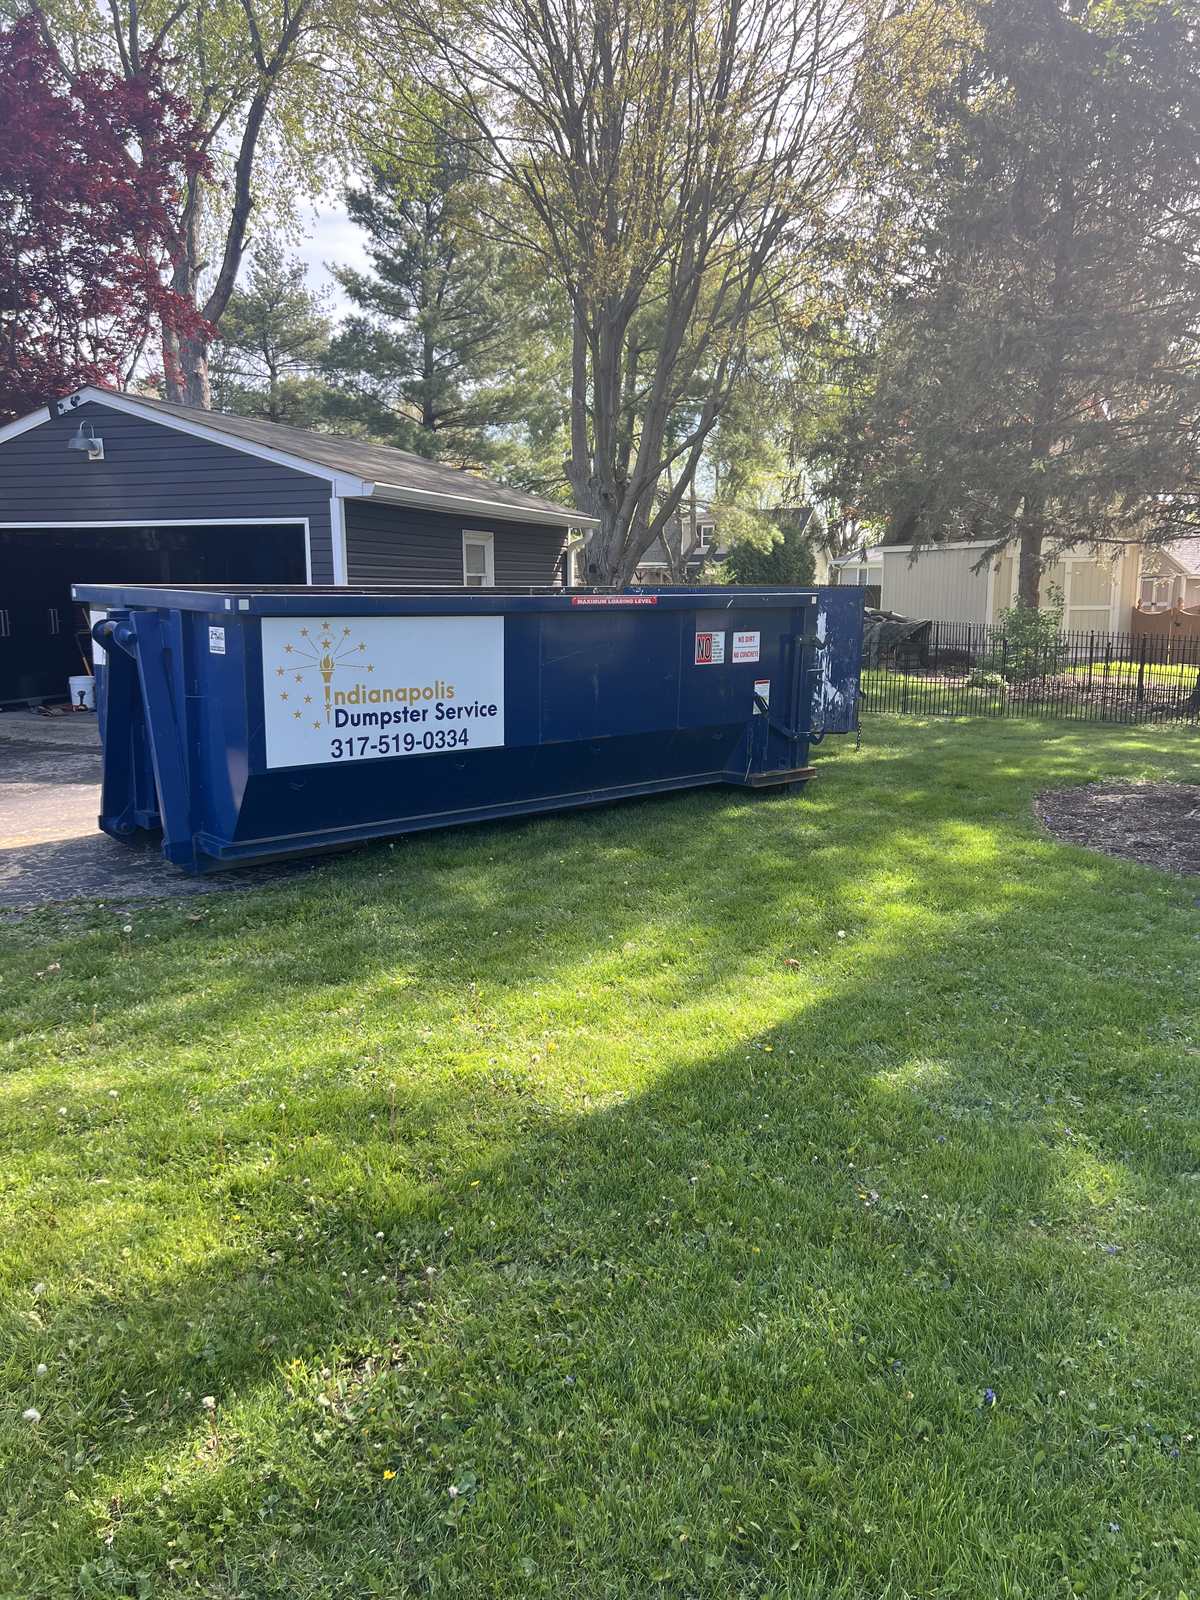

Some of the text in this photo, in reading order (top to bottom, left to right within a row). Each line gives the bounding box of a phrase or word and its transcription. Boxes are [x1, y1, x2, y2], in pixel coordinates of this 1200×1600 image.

[697, 637, 712, 659] NO
[324, 680, 456, 706] Indianapolis
[335, 701, 498, 729] Dumpster Service
[330, 728, 469, 758] 317-519-0334
